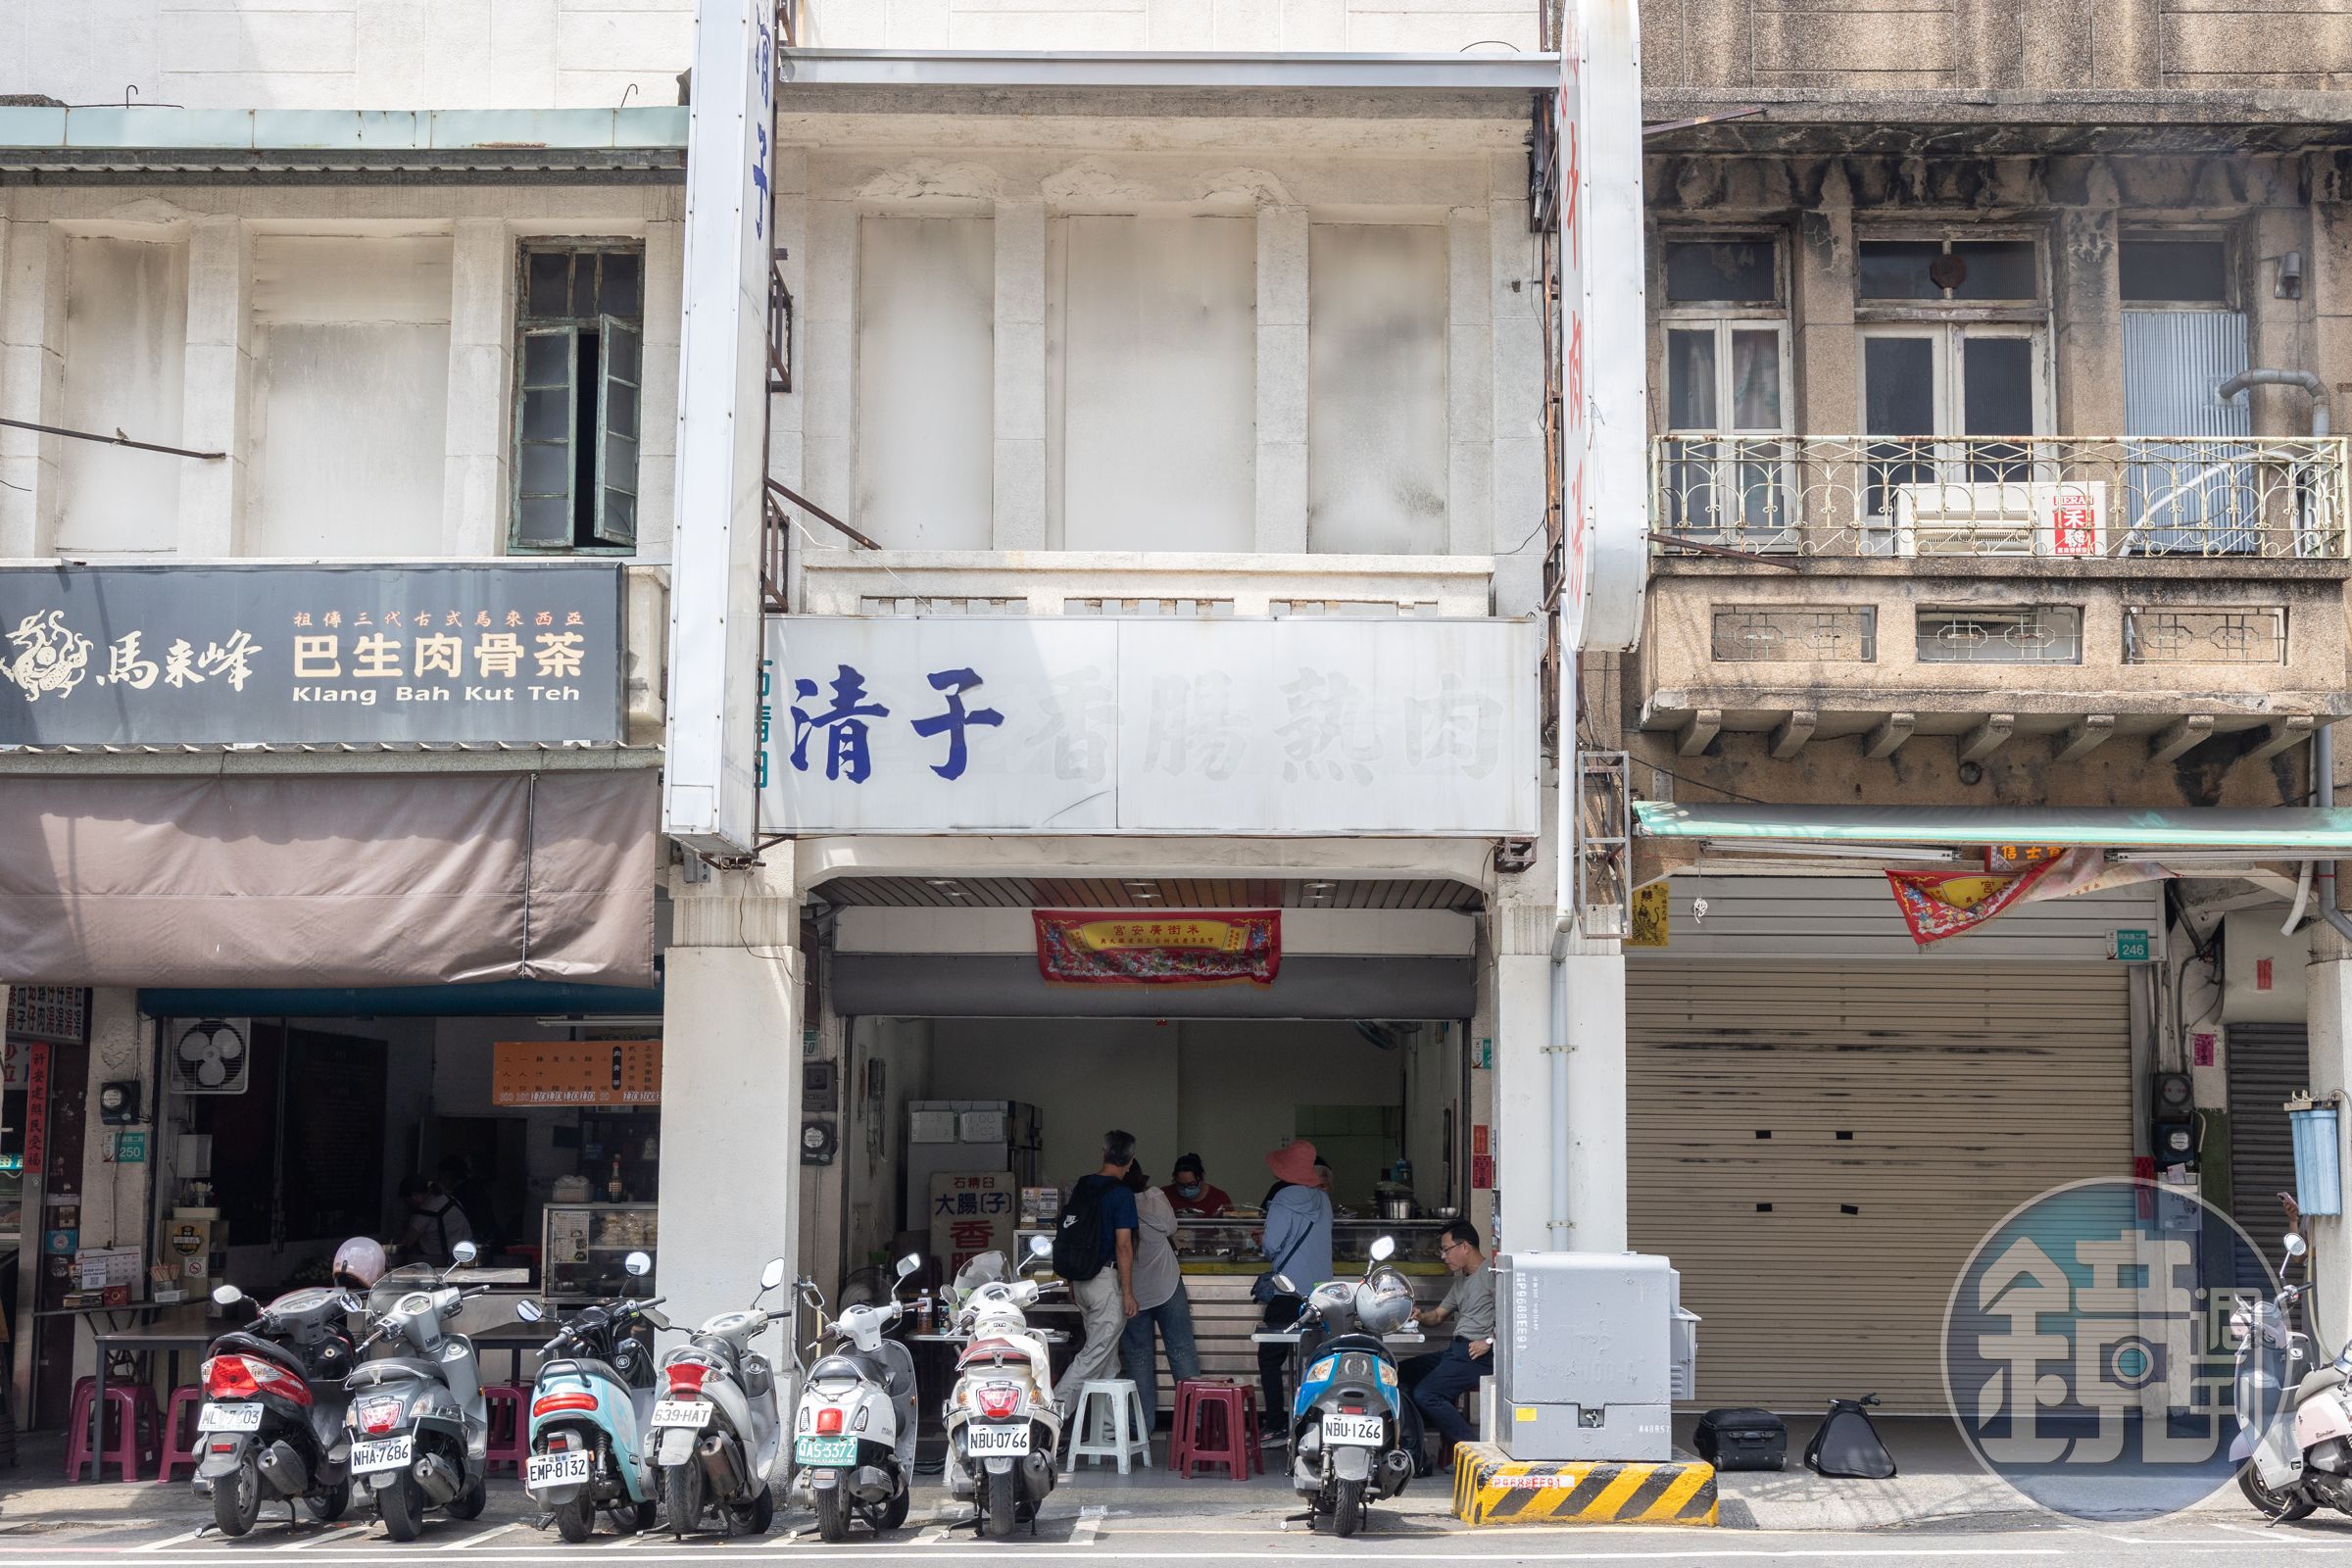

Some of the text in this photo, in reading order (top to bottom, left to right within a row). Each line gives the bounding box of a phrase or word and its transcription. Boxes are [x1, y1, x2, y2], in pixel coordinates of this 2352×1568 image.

[295, 611, 585, 628] 祖傳三代古式馬來西亞
[294, 633, 585, 679] 巴生肉骨茶
[293, 686, 580, 706] Klang Bah Kut Teh
[2123, 944, 2144, 956] 246
[120, 1147, 141, 1157] 250
[954, 1177, 995, 1189] 石精臼
[1325, 1422, 1381, 1440] NBU-1266
[970, 1432, 1027, 1448] NBU-0766
[353, 1446, 409, 1466] NHA-7686
[530, 1459, 586, 1482] EMP-8132
